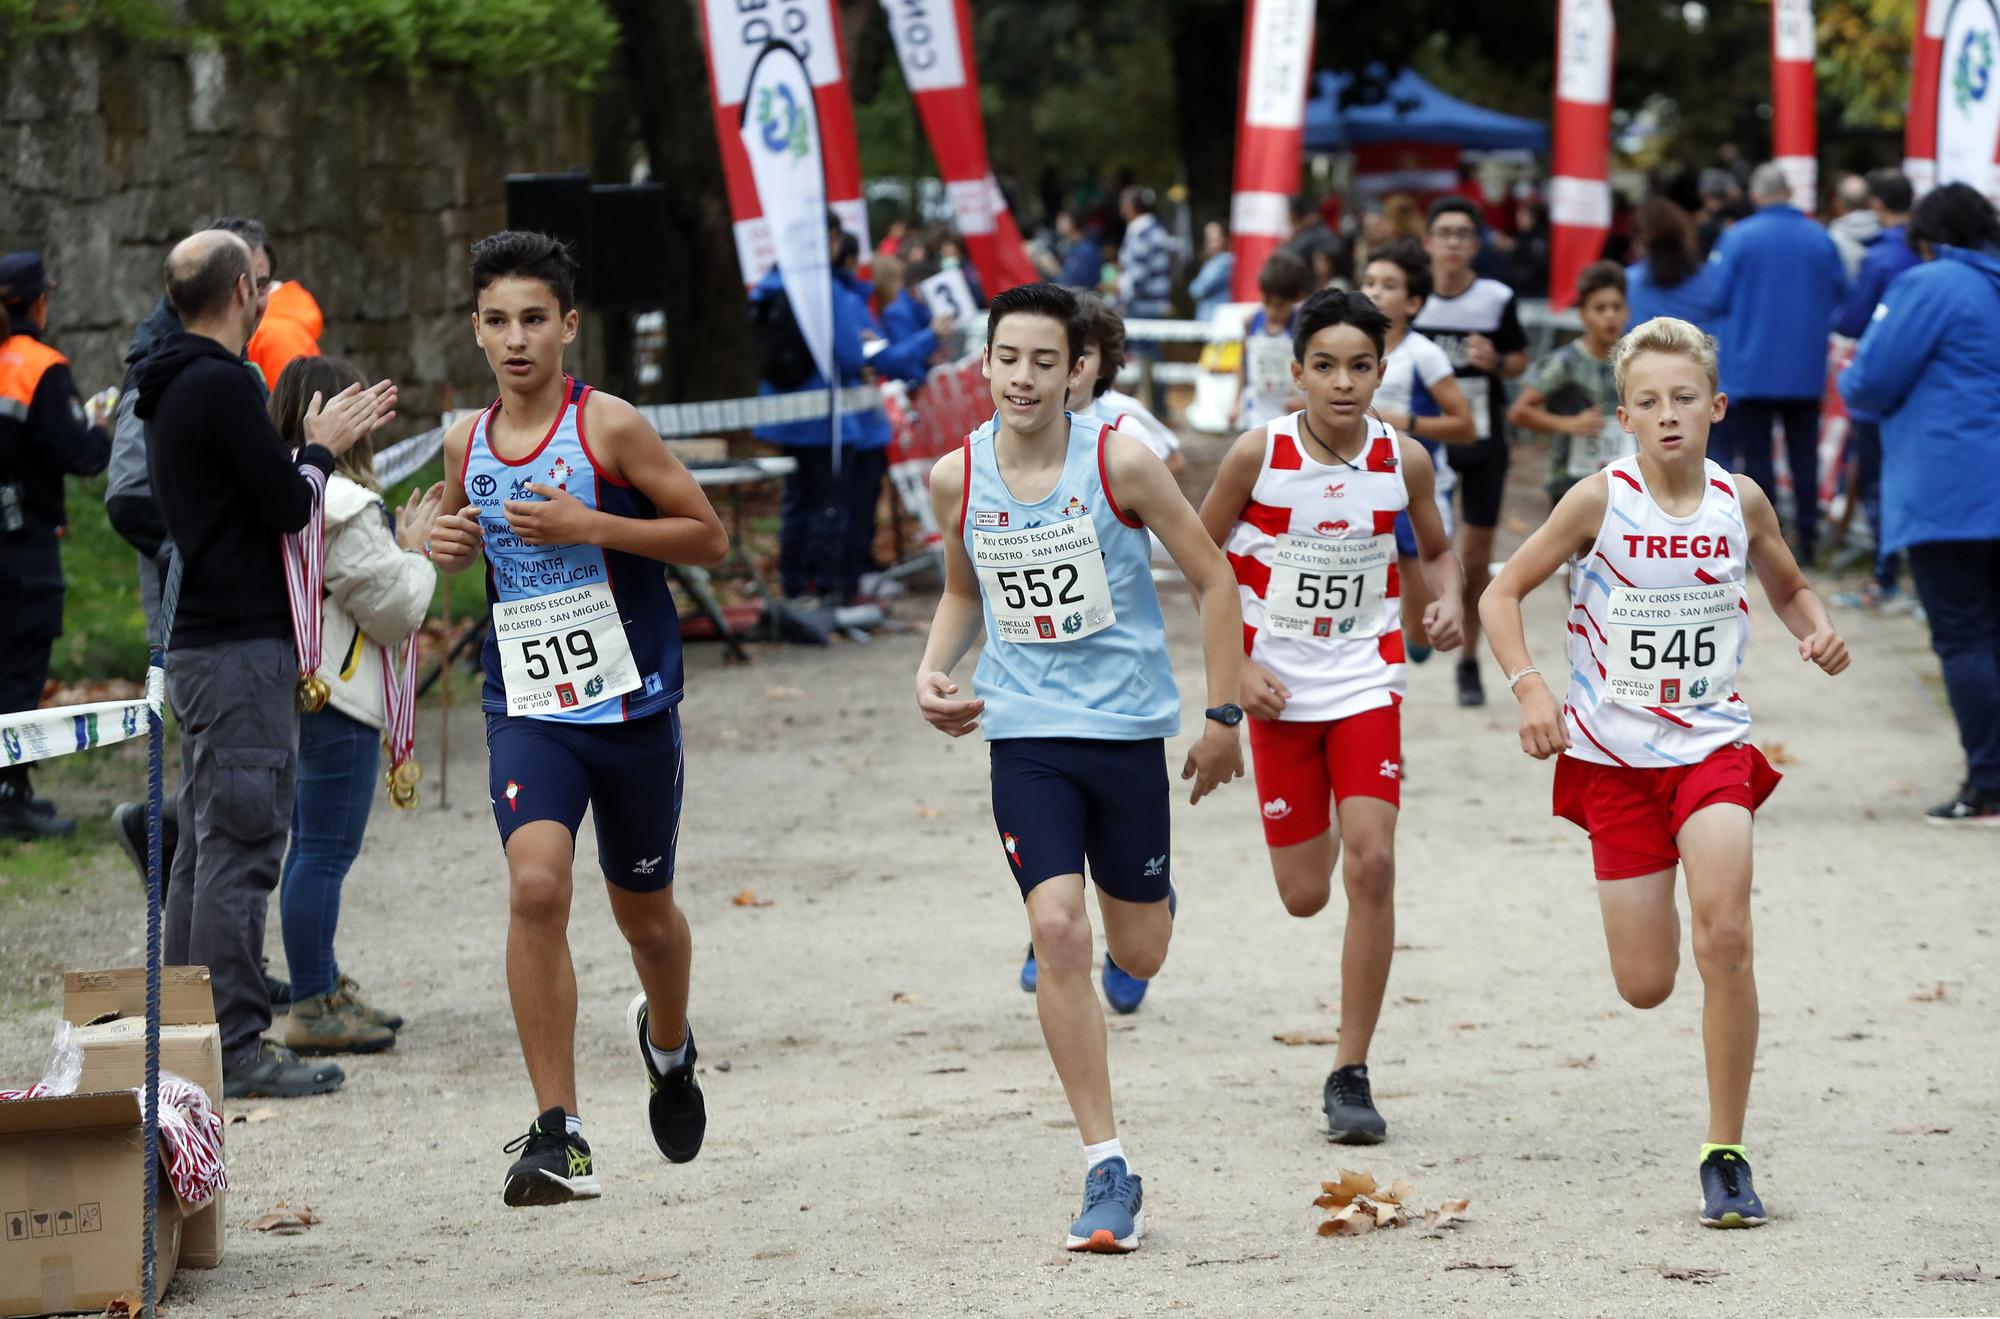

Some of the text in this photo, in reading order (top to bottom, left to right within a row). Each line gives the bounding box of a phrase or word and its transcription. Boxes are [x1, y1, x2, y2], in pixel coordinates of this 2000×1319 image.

[510, 491, 534, 500] ZICO
[488, 524, 515, 535] CONC
[982, 525, 1075, 546] XXV CROSS ESCOLAR
[977, 551, 988, 560] AD
[988, 551, 1023, 561] CASTRO
[1031, 547, 1052, 558] SAN
[1054, 536, 1094, 553] MIGUEL
[1290, 539, 1378, 552] XXV CROSS ESCOLAR
[1623, 535, 1730, 559] TREGA
[519, 557, 564, 573] XUNTA
[1278, 551, 1292, 559] AD
[1293, 553, 1331, 565] CASTRO
[1339, 556, 1357, 565] SAN
[1359, 552, 1386, 563] MIGUEL
[522, 564, 600, 588] DE GALICIA
[997, 563, 1085, 610] 552
[1295, 572, 1365, 610] 551
[503, 590, 592, 617] XXV CROSS ESCOLAR
[1624, 589, 1725, 603] XXV CROSS ESCOLAR
[499, 624, 510, 632] AD
[511, 619, 542, 631] CASTRO
[549, 612, 571, 624] SAN
[572, 600, 611, 617] MIGUEL
[1612, 607, 1628, 617] AD
[1630, 608, 1671, 618] CASTRO
[1680, 607, 1701, 617] SAN
[1703, 602, 1735, 615] MIGUEL
[997, 618, 1031, 628] CONCELLO
[1274, 621, 1304, 630] DE VIGO
[1014, 627, 1029, 635] VIGO
[521, 629, 599, 680] 519
[1629, 626, 1716, 670] 546
[1611, 679, 1655, 690] CONCELLO
[1616, 687, 1650, 697] DE VIGO
[512, 690, 552, 704] CONCELLO
[531, 699, 550, 709] VIGO
